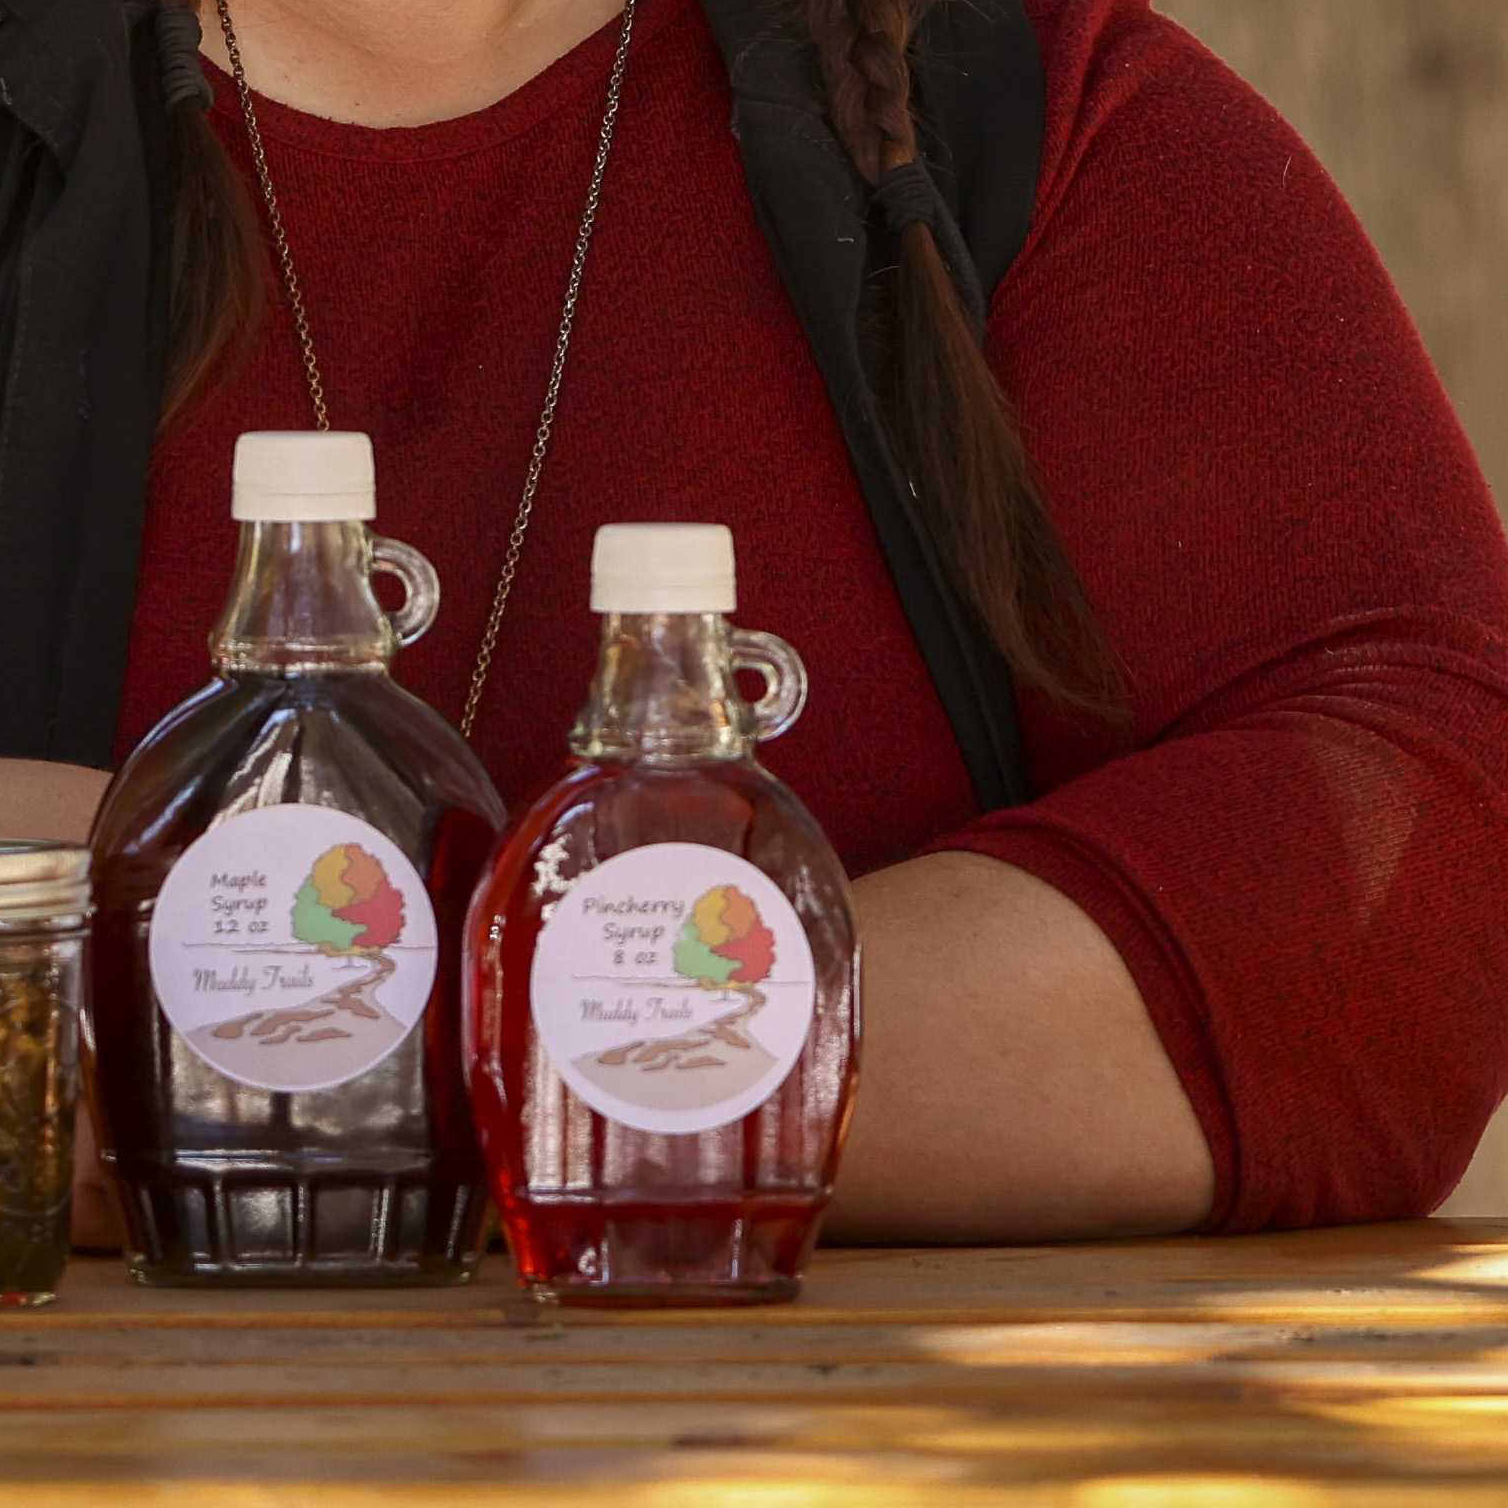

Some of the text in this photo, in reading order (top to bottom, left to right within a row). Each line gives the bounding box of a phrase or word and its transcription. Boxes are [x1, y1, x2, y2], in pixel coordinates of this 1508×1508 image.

[210, 870, 266, 892] Maple
[211, 895, 269, 916] Syrup
[582, 896, 686, 917] Pincherry
[214, 921, 270, 934] 12 oz
[603, 922, 665, 945] Syrup
[613, 951, 658, 965] 8 oz
[193, 964, 314, 996] Muddy Trails
[580, 998, 640, 1024] Muddy
